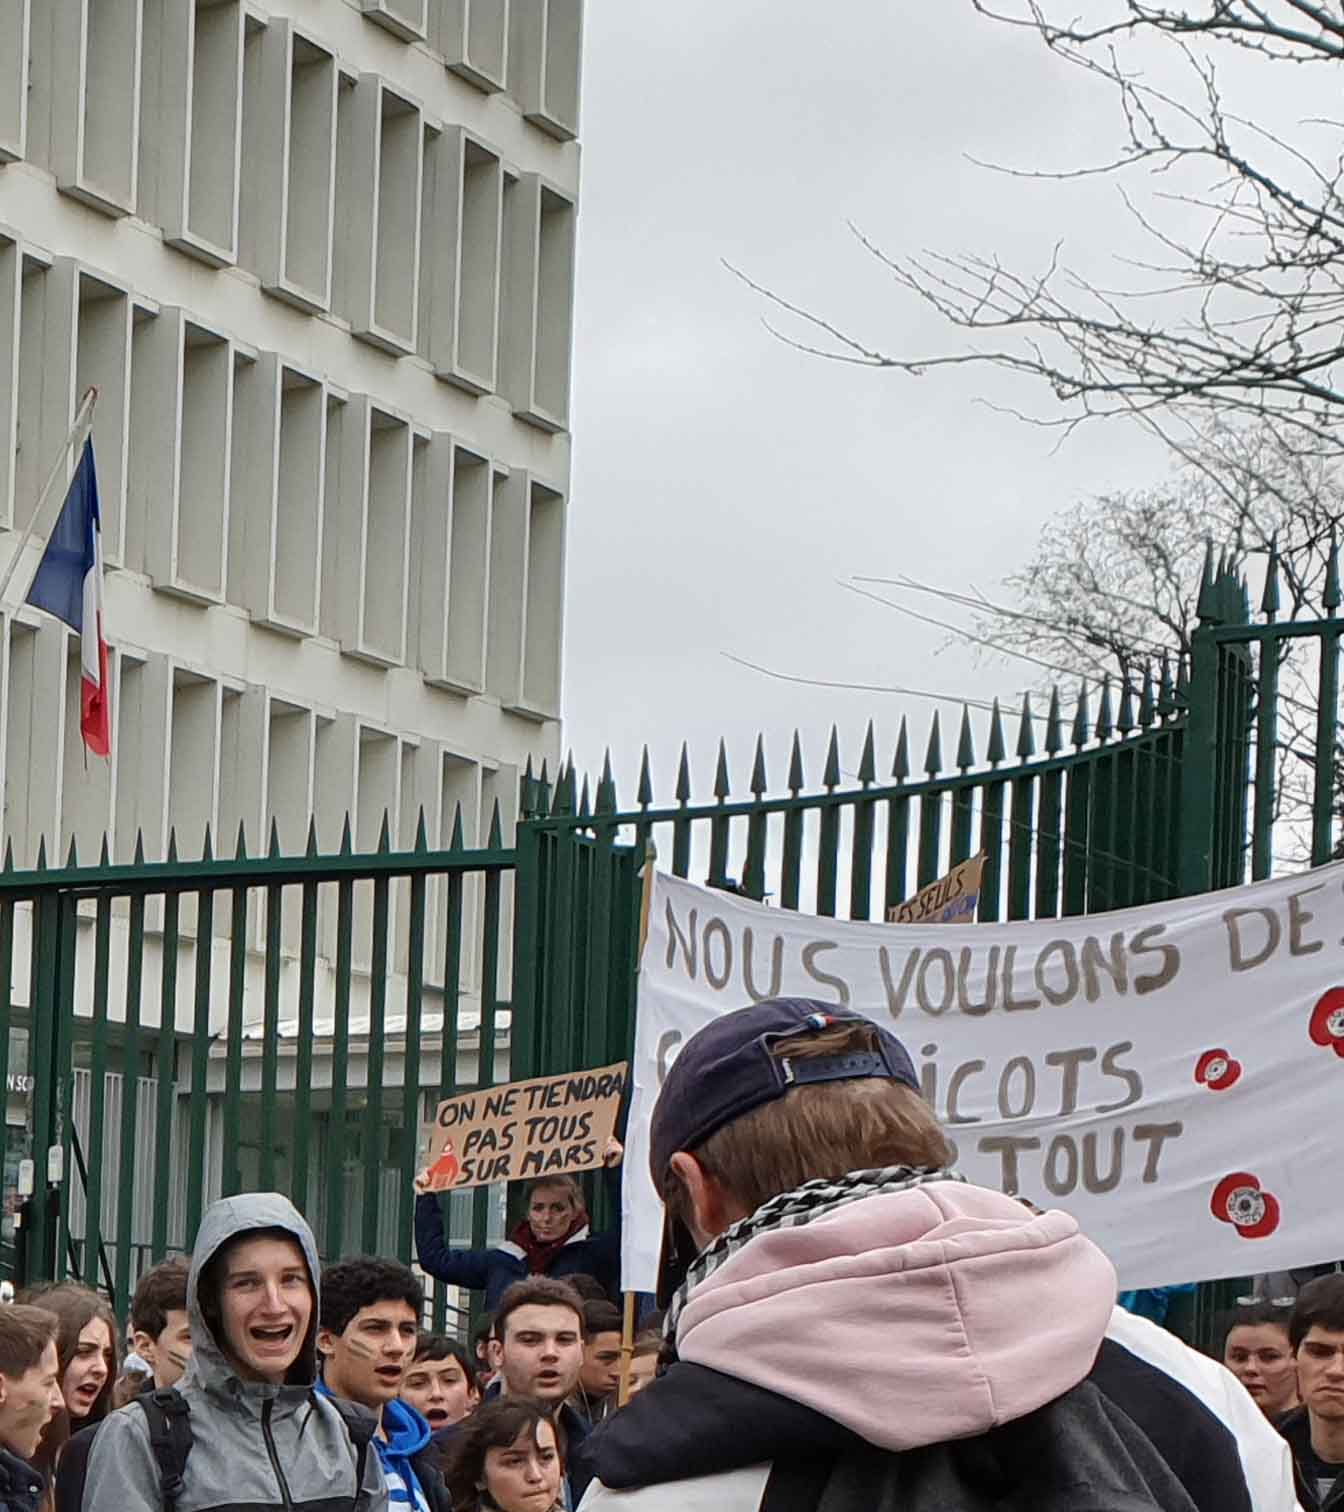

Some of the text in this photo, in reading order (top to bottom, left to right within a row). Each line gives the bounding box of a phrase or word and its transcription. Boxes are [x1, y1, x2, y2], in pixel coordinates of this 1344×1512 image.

[665, 883, 1344, 1019] NOUS VOULONS DE
[439, 1071, 626, 1128] ON NE TIENDRA
[462, 1111, 594, 1158] PAS TOUS
[455, 1140, 597, 1186] SUR MARS
